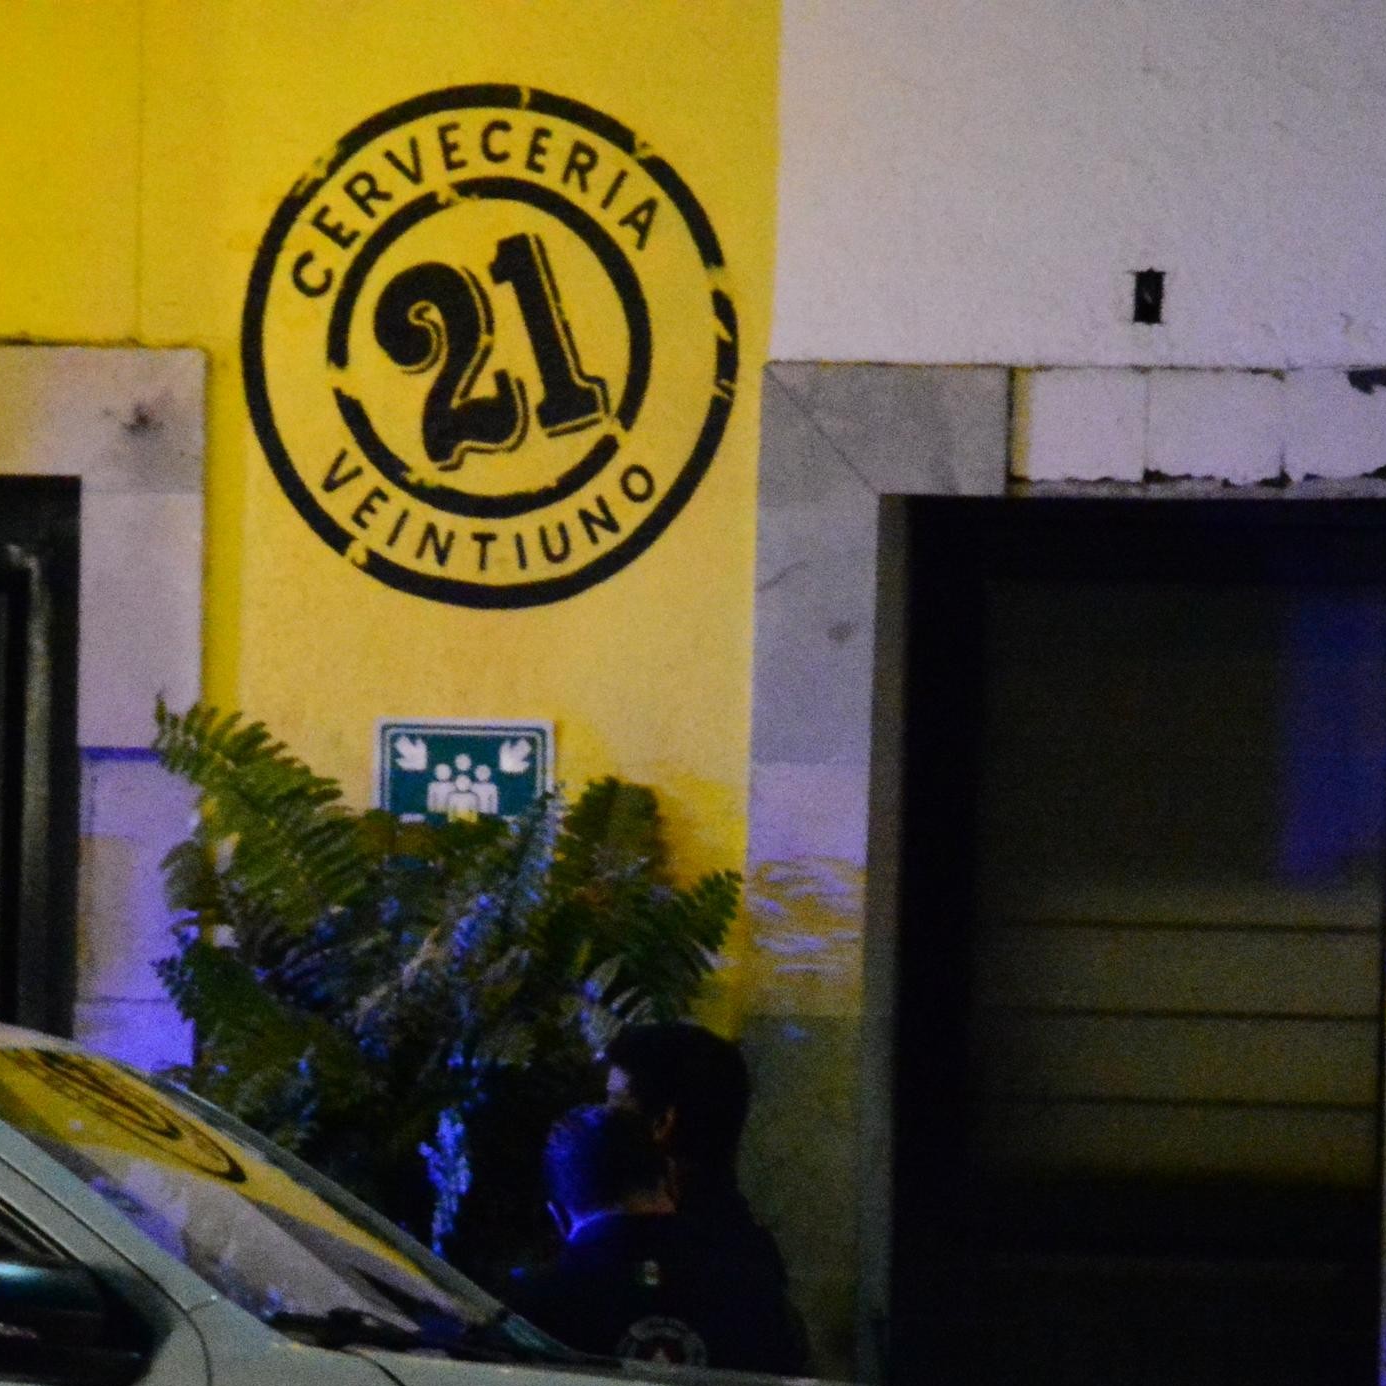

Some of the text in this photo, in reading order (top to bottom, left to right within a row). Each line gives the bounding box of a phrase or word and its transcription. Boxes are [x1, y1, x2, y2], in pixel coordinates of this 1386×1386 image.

[291, 119, 659, 299] CERVECERIA
[373, 232, 612, 471] 21
[321, 449, 656, 572] VEINTIUNO
